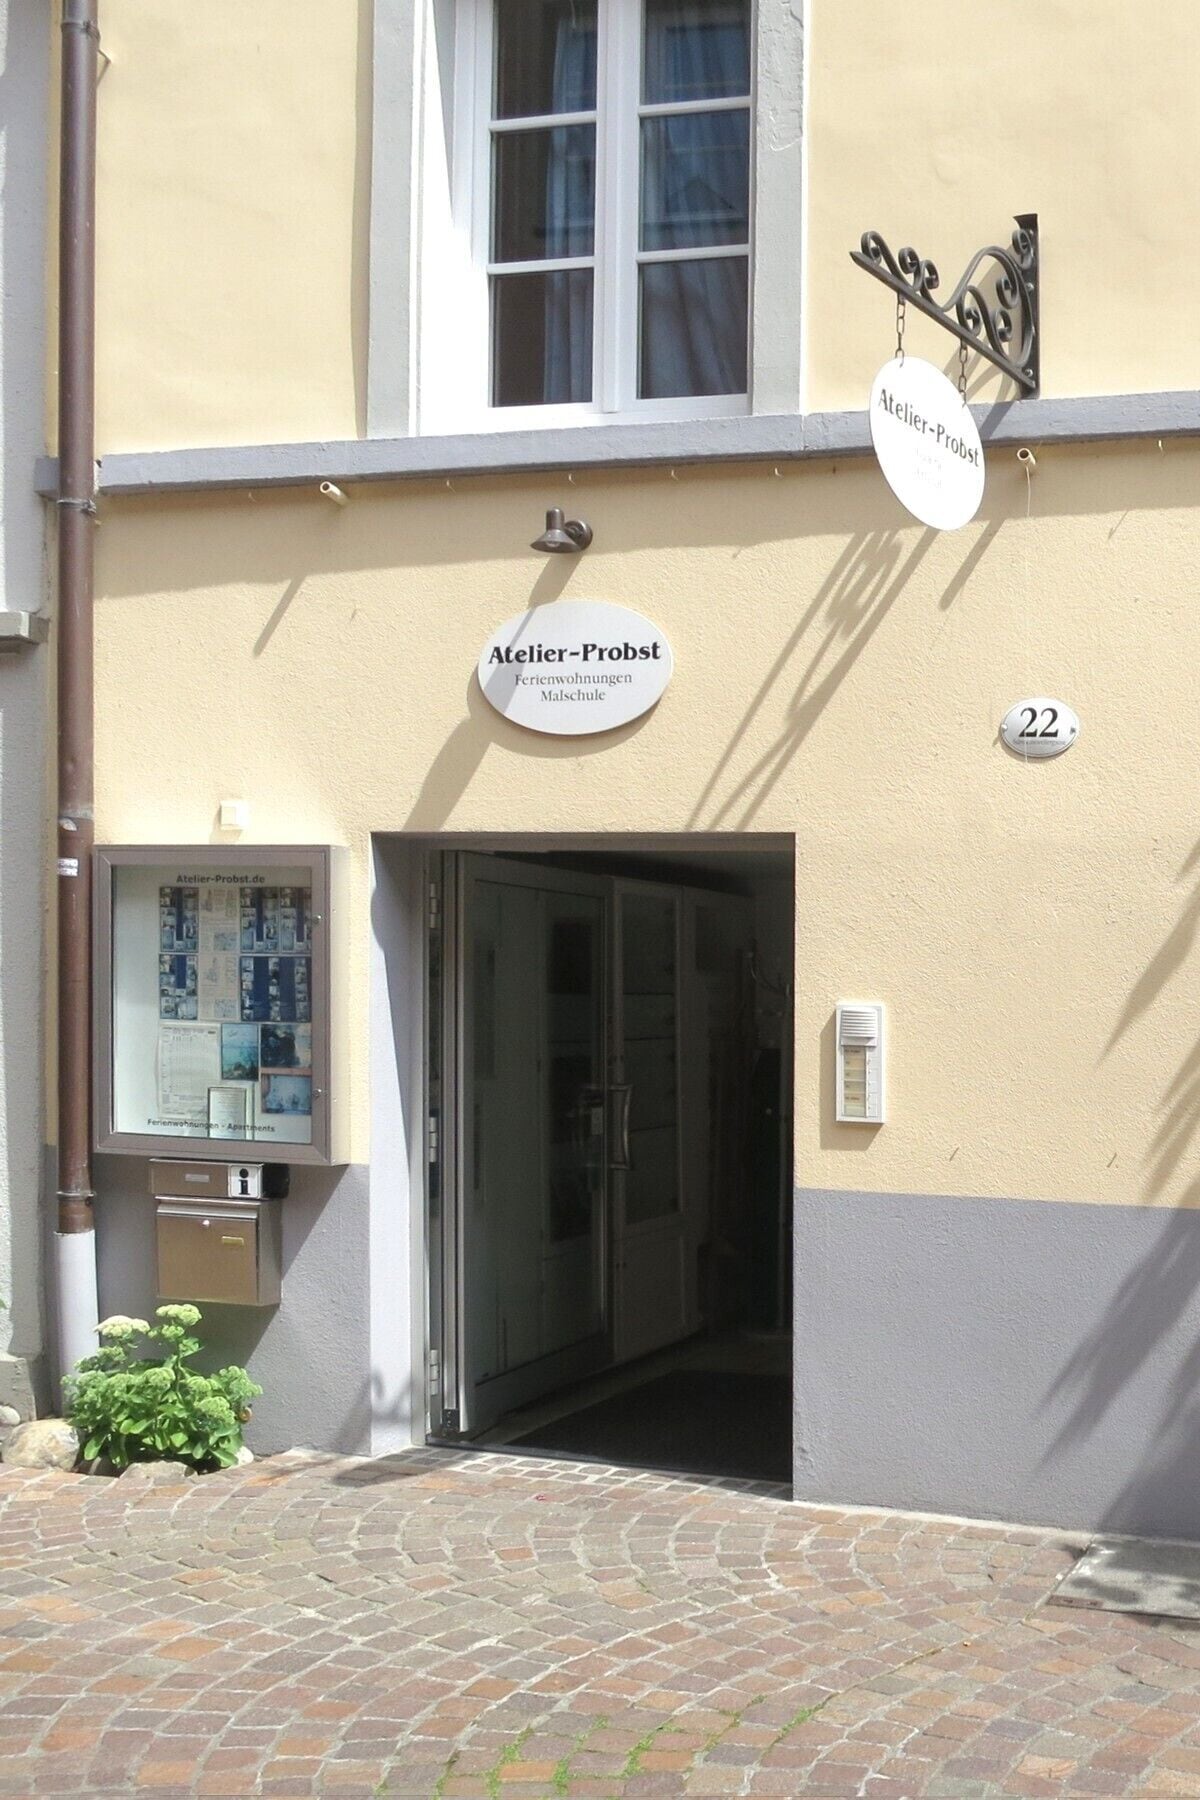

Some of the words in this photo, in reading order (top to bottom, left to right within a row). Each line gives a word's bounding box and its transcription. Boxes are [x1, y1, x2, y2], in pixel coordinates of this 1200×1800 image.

[878, 388, 980, 468] Atelier-Probst
[488, 641, 661, 664] Atelier-Probst
[514, 672, 633, 687] Ferienwohnungen
[540, 689, 606, 702] Malschule
[1018, 707, 1059, 738] 22
[176, 874, 265, 884] Atelier-Probst.de
[147, 1118, 219, 1129] Ferienwohnungen
[226, 1122, 276, 1133] Apartments
